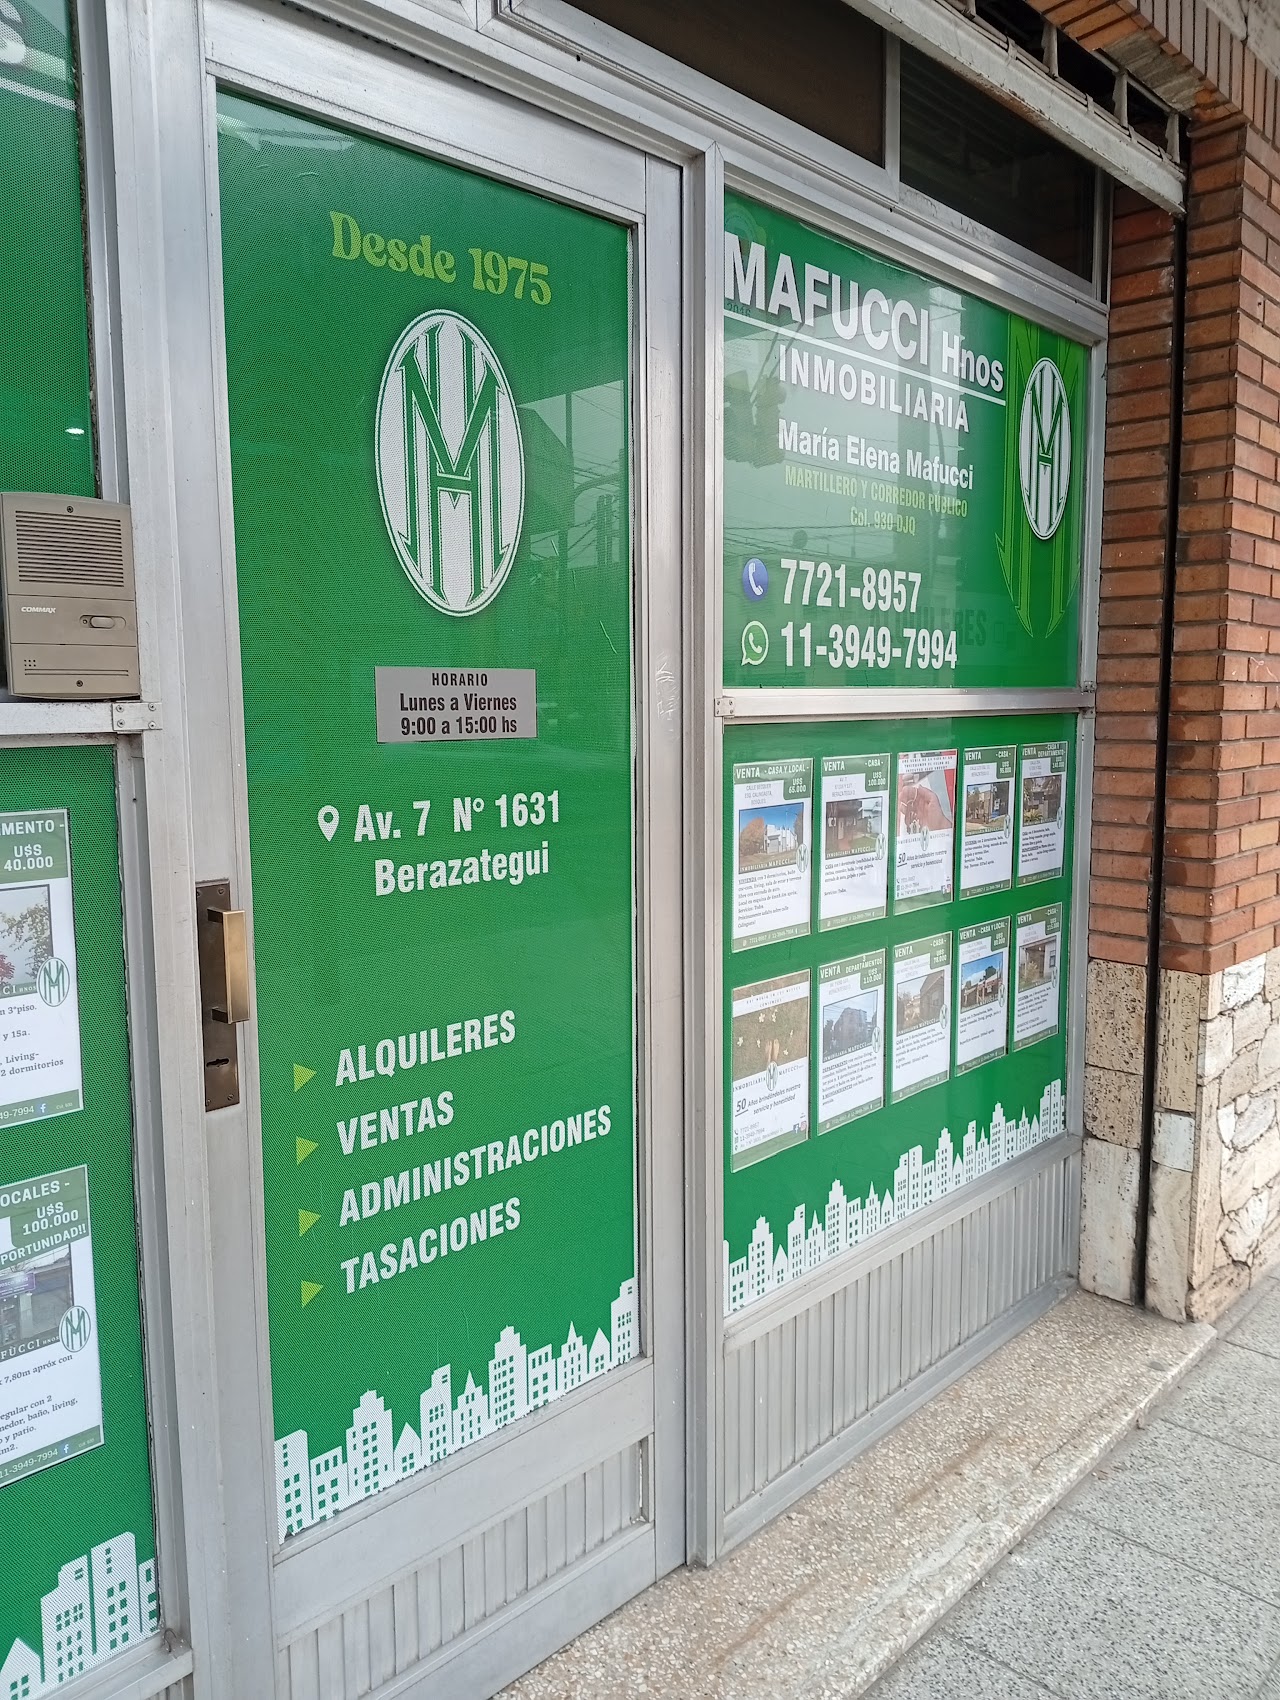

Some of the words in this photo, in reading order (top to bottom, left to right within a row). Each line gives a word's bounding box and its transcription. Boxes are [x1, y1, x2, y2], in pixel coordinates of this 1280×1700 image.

[330, 211, 456, 283] Desde
[468, 248, 552, 306] 1975
[724, 231, 929, 366] MAFUCCI
[941, 330, 1005, 392] Hnos
[779, 344, 970, 433] INMOBILIARIA
[778, 418, 840, 462] María
[847, 435, 900, 474] Elena
[906, 449, 973, 490] Mafucci
[785, 465, 857, 498] MARTILLERO
[861, 480, 869, 498] Y
[871, 482, 926, 510] CORREDOR
[928, 490, 968, 518] PÚBLICO
[850, 506, 870, 527] Col.
[874, 510, 894, 531] 930
[896, 515, 916, 536] DJQ
[780, 558, 922, 613] 7721-8957
[21, 606, 57, 614] COMMAX
[781, 621, 957, 669] 11-3949-7994
[432, 673, 488, 686] HORARIO
[400, 693, 445, 711] Lunes
[450, 697, 459, 711] a
[464, 693, 517, 711] Viernes
[401, 717, 436, 736] 9:00
[441, 720, 450, 735] a
[456, 716, 497, 734] 15:00
[502, 716, 517, 733] hs
[824, 760, 845, 771] VENTA
[965, 752, 981, 760] VENTA
[736, 767, 760, 779] VENTA
[353, 804, 401, 843] Av.
[413, 800, 431, 836] 7
[495, 790, 559, 828] 1631
[0, 819, 55, 836] MENTO
[14, 843, 42, 858] U$S
[898, 852, 906, 863] 50
[3, 856, 54, 872] 40.000
[374, 841, 549, 896] Berazategui
[895, 946, 913, 958] VENTA
[820, 965, 841, 979] VENTA
[335, 1010, 516, 1087] ALQUILERES
[9, 1059, 64, 1075] dormitorios
[736, 1098, 747, 1113] 50
[336, 1091, 454, 1156] VENTAS
[339, 1105, 612, 1227] ADMINISTRACIONES
[0, 1180, 60, 1207] OCALES
[36, 1202, 64, 1218] U$S
[22, 1209, 79, 1236] 100.000
[0, 1223, 87, 1265] PORTUNIDAD!!
[340, 1197, 521, 1294] TASACIONES
[33, 1360, 56, 1374] apróx
[58, 1354, 73, 1364] con
[30, 1400, 45, 1409] con
[27, 1409, 50, 1421] baño,
[5, 1434, 10, 1443] y
[12, 1426, 36, 1440] patio.
